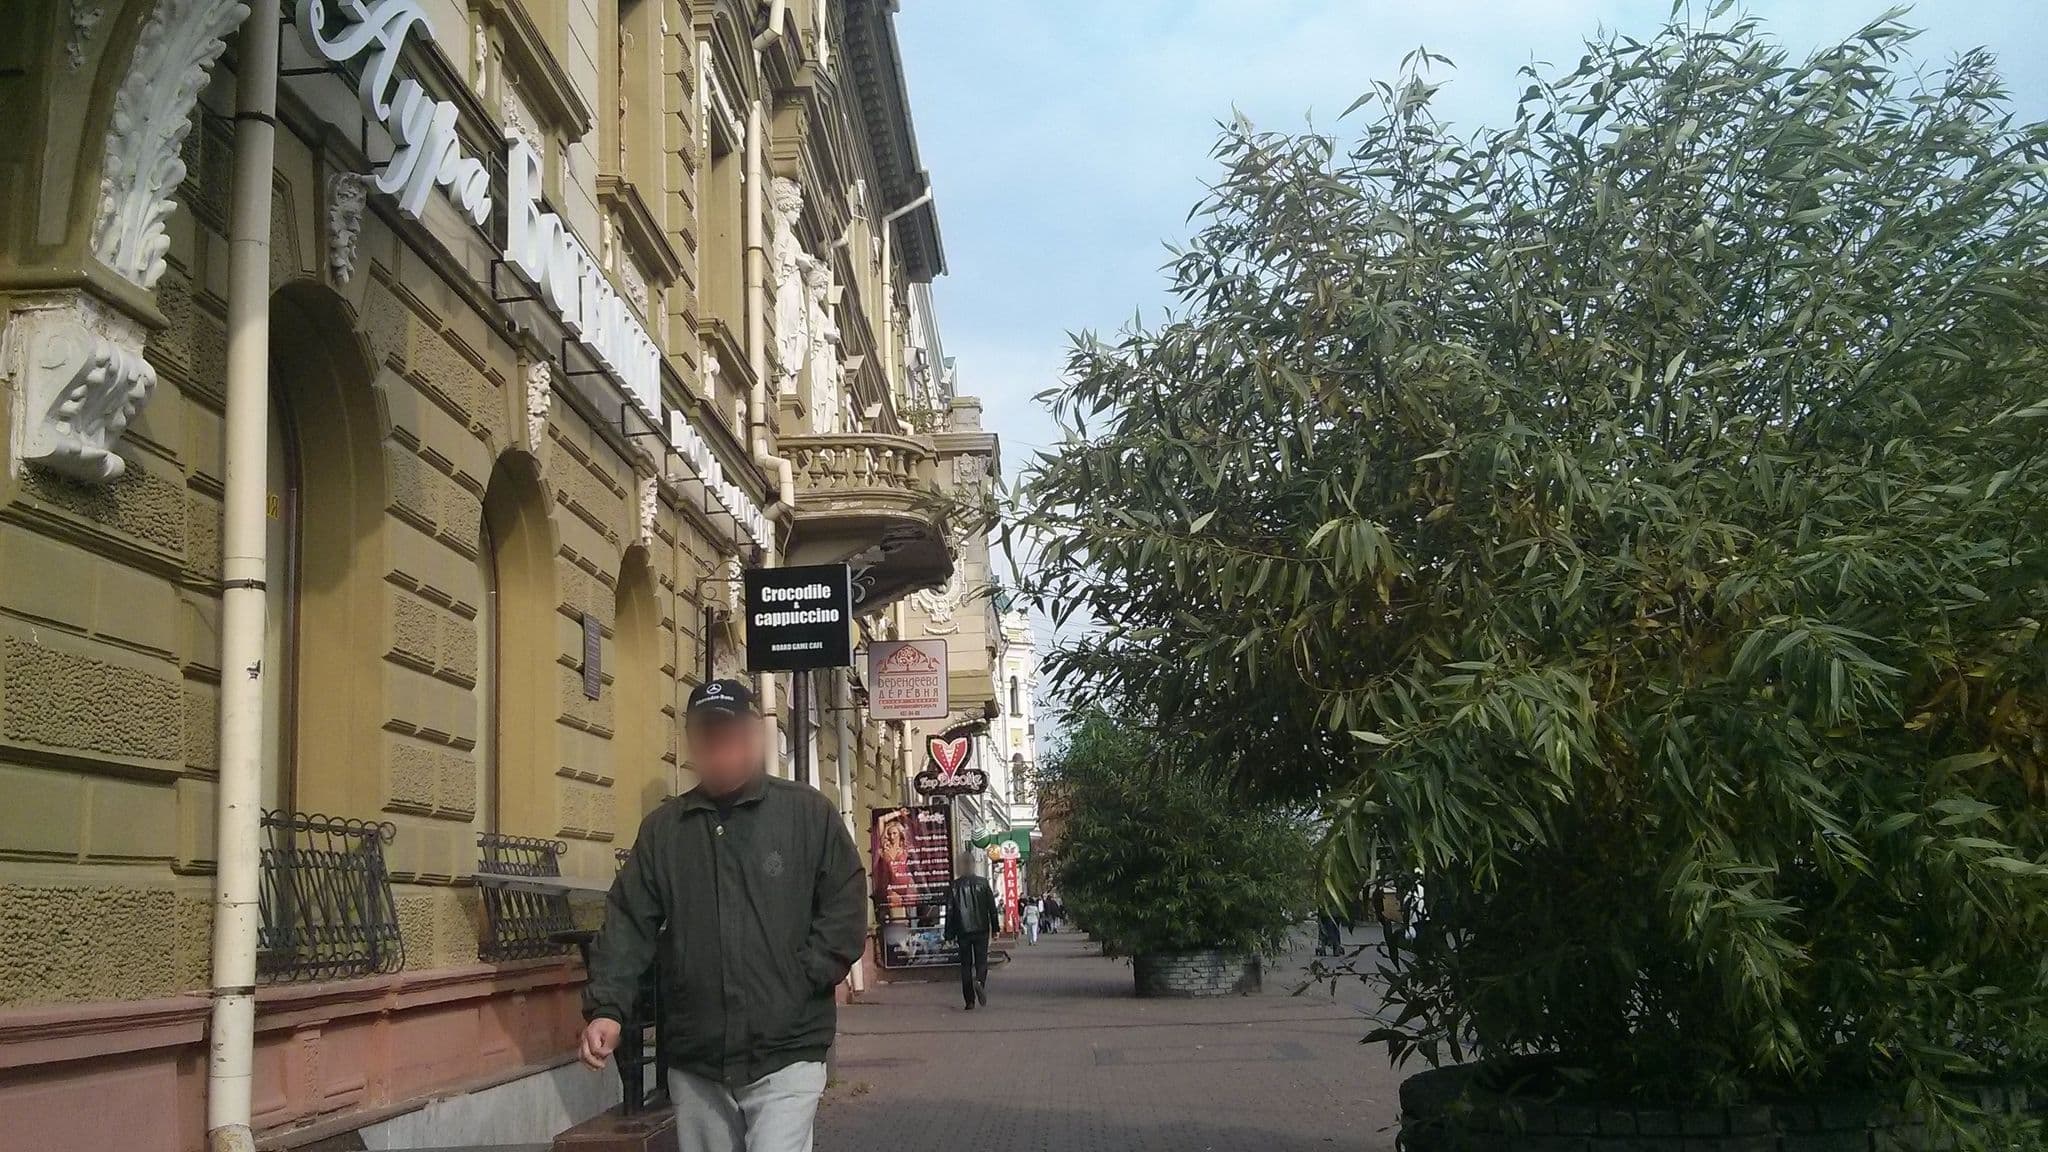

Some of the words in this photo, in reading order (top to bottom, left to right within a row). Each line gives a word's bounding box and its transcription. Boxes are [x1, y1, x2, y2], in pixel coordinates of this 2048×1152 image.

[761, 583, 832, 602] Crocodile
[754, 607, 840, 627] cappuccino
[878, 687, 939, 699] ДЕРЕВНЯ
[1007, 860, 1016, 908] ТАБАК
